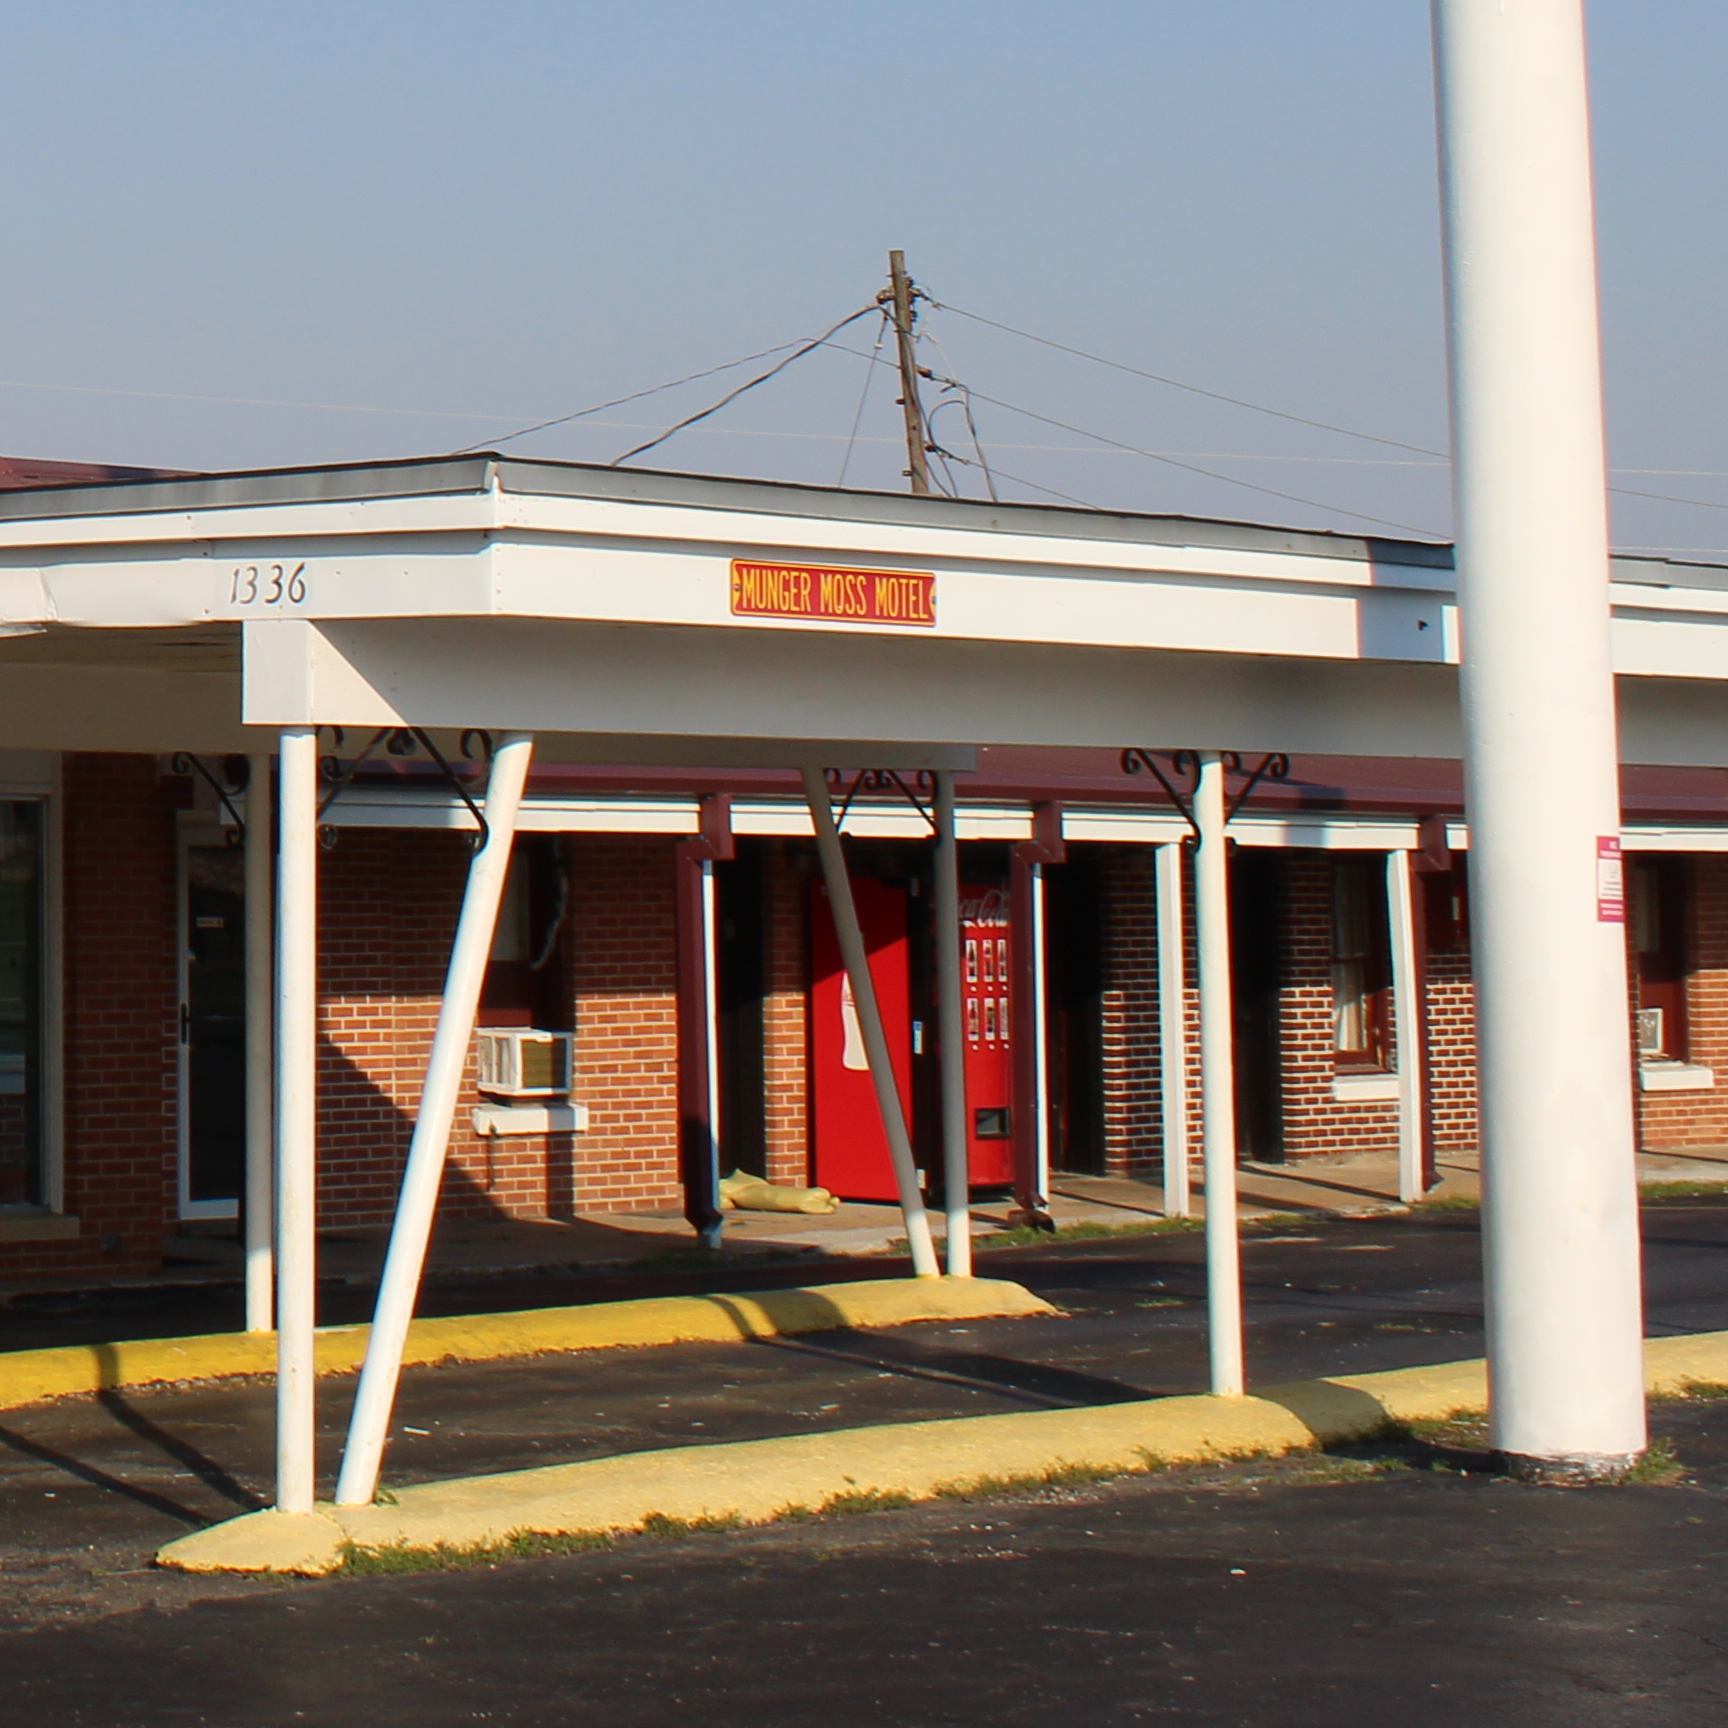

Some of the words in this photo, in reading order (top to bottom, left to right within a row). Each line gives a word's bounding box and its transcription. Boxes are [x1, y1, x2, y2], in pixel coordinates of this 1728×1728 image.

[229, 562, 307, 605] 1336
[742, 566, 811, 612] MUNGER
[820, 571, 867, 616] MOSS
[875, 575, 930, 620] MOTEL
